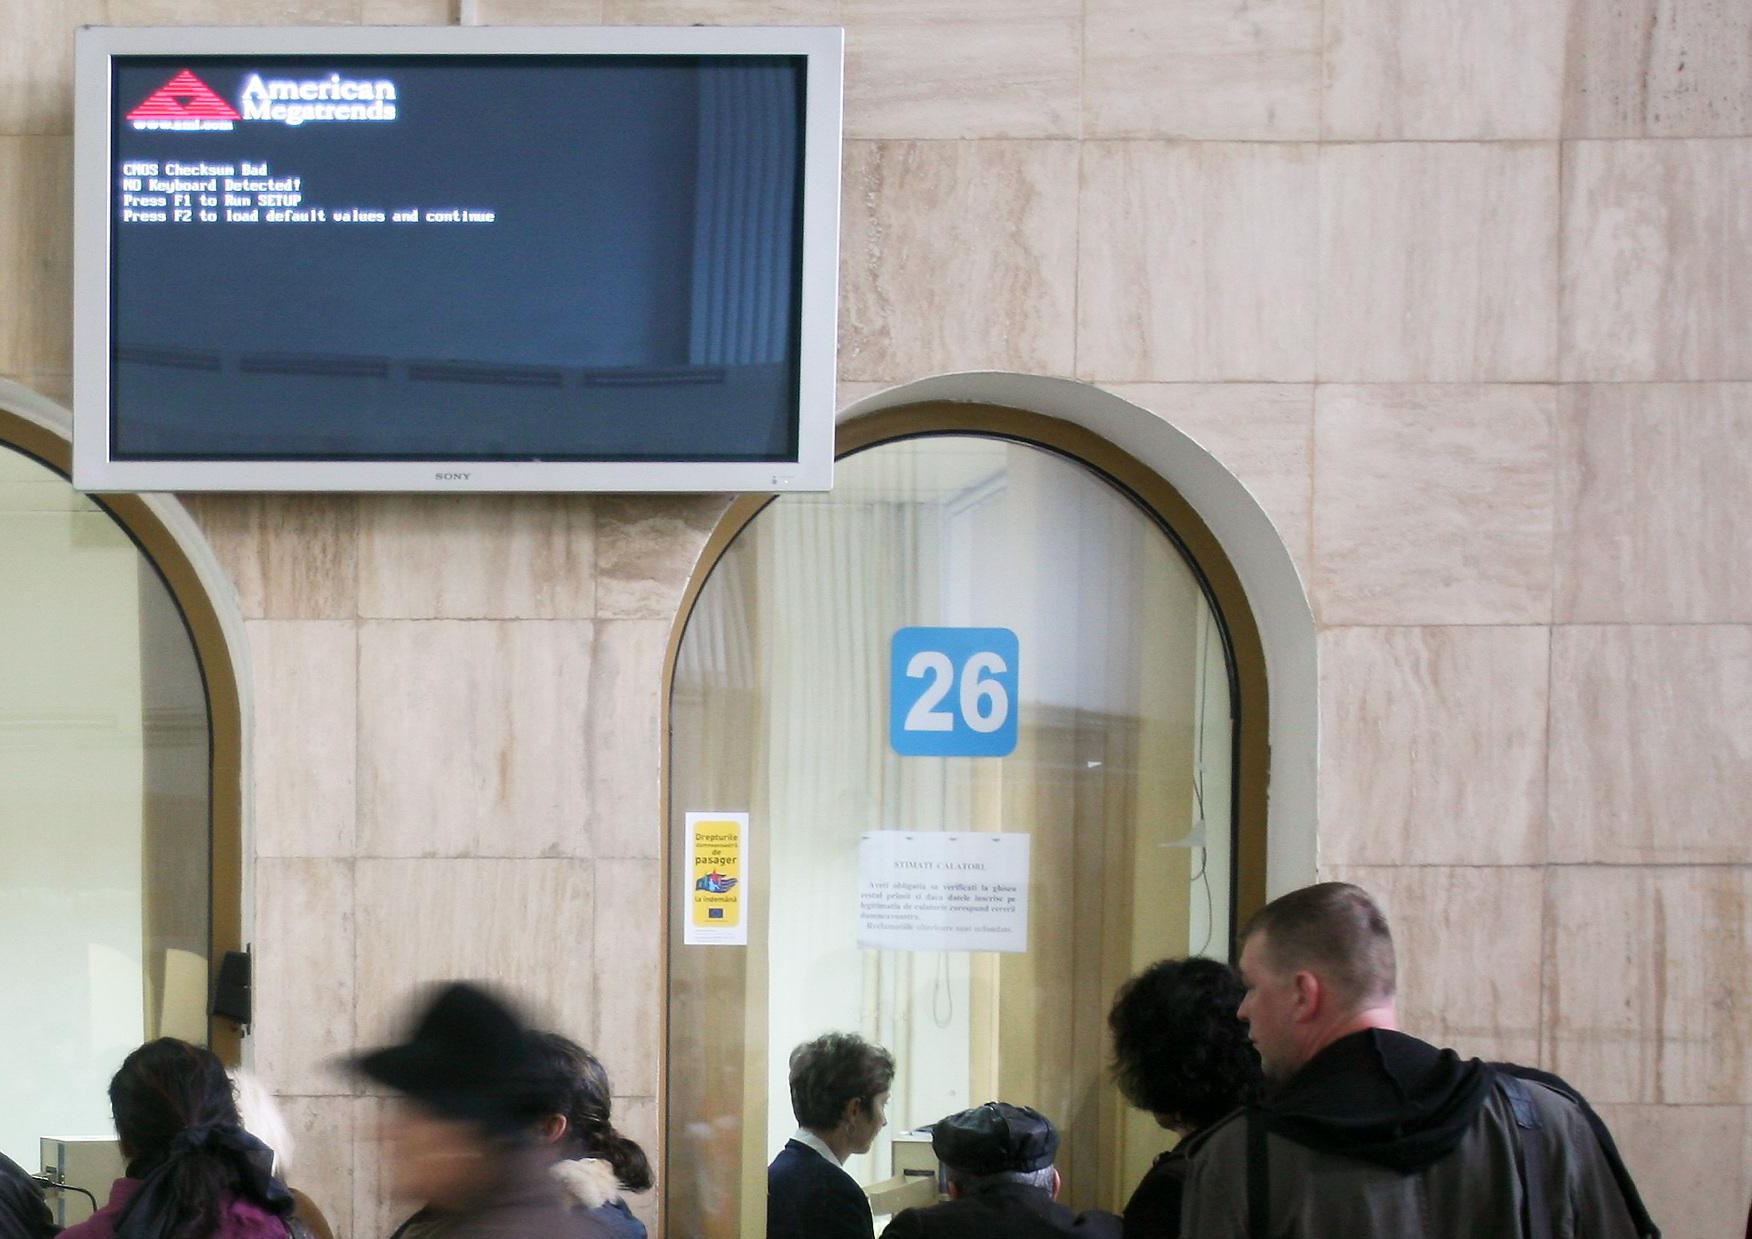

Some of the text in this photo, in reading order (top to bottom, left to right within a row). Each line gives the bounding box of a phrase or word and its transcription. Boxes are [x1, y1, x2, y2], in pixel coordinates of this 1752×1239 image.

[242, 74, 396, 100] American
[242, 99, 396, 126] Megatrends
[123, 162, 268, 176] CMOS Checksum Bad
[123, 178, 301, 194] NO Keyboard Detected!
[123, 194, 302, 207] Press F1 to Run SETUP
[123, 209, 496, 223] Press F2 to load default values and continue
[434, 472, 471, 481] SONY
[904, 651, 1008, 733] 26
[695, 833, 738, 842] Drepturile
[695, 856, 737, 866] pasager
[894, 861, 933, 869] STIMATI
